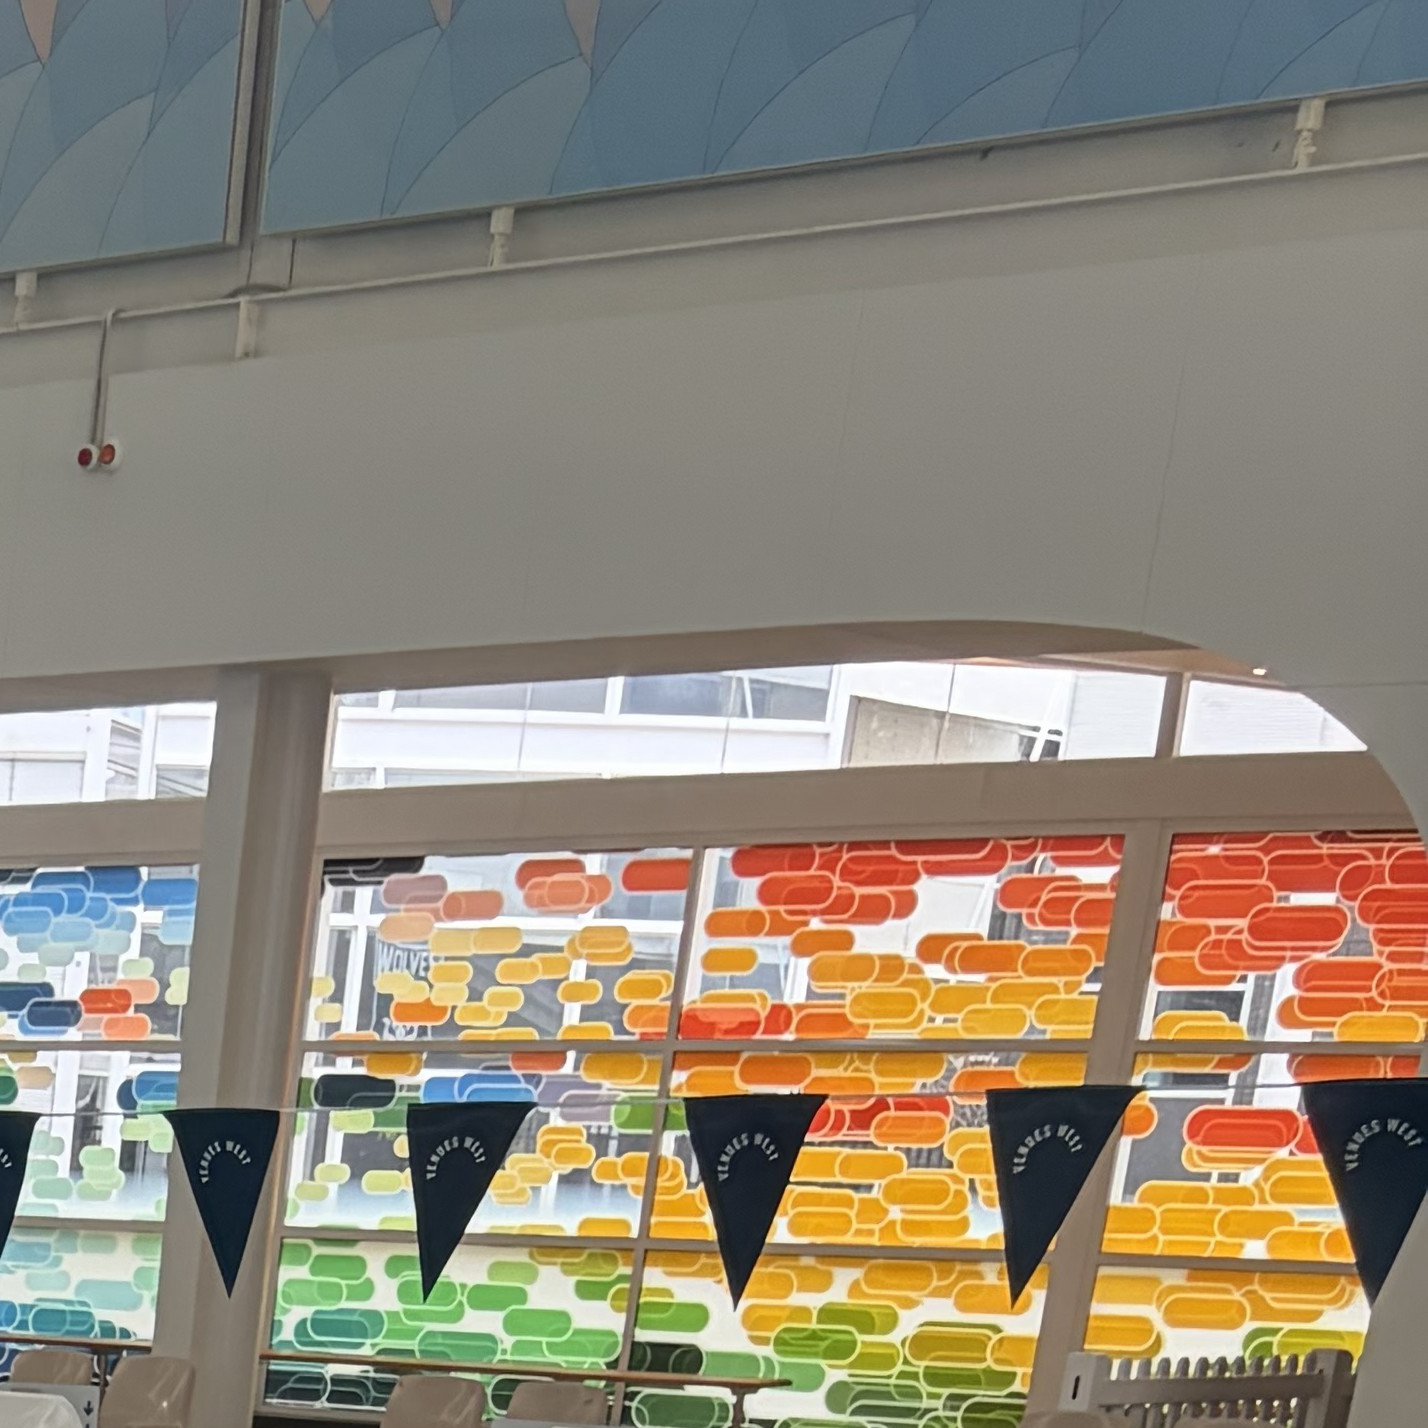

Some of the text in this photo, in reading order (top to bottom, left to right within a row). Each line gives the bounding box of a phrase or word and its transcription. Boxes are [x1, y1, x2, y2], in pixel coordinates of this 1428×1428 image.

[377, 942, 445, 977] WOLVE
[717, 1132, 749, 1182] VENUES
[1012, 1124, 1083, 1175] VENUES WEST
[1344, 1118, 1423, 1172] VENUES WEST
